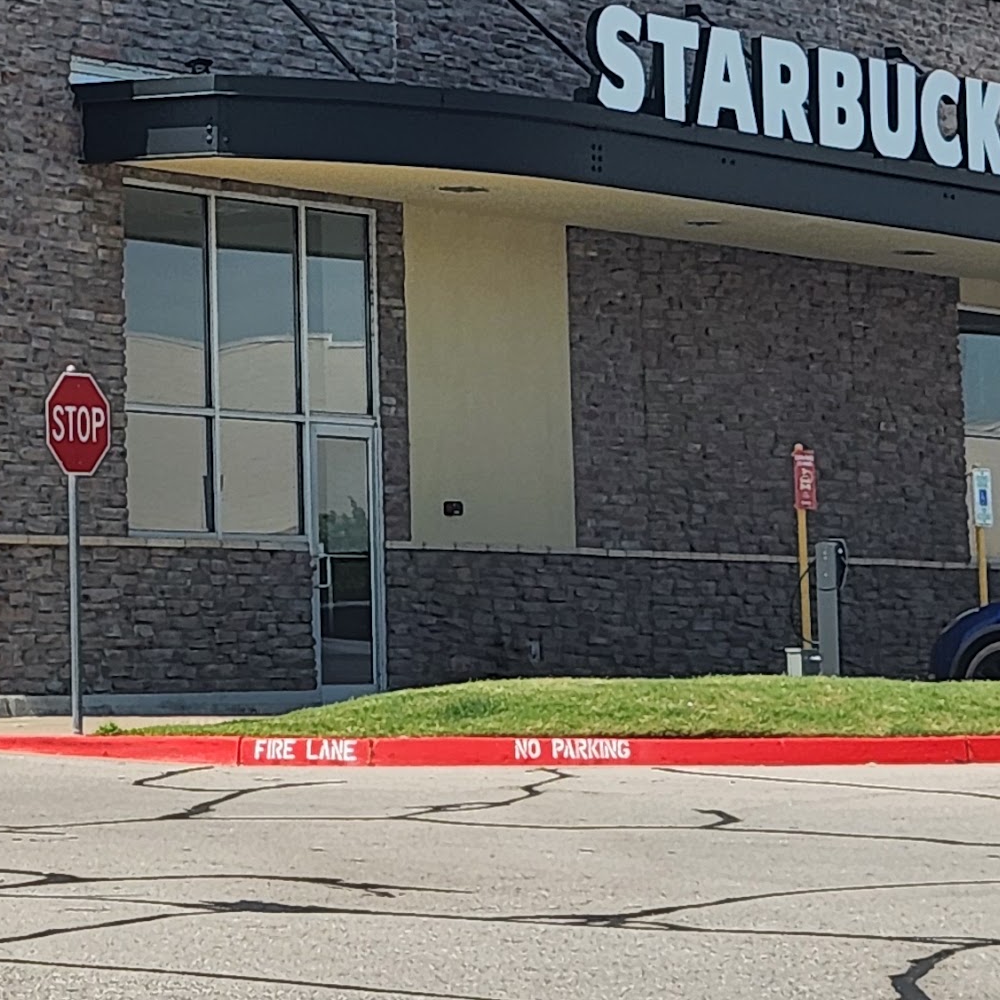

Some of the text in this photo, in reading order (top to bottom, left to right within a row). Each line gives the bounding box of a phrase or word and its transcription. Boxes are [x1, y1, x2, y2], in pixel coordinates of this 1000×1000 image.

[595, 4, 1000, 175] STARBUCK
[51, 404, 106, 443] STOP
[253, 738, 358, 762] FIRE LANE
[514, 737, 631, 760] NO PARKING
